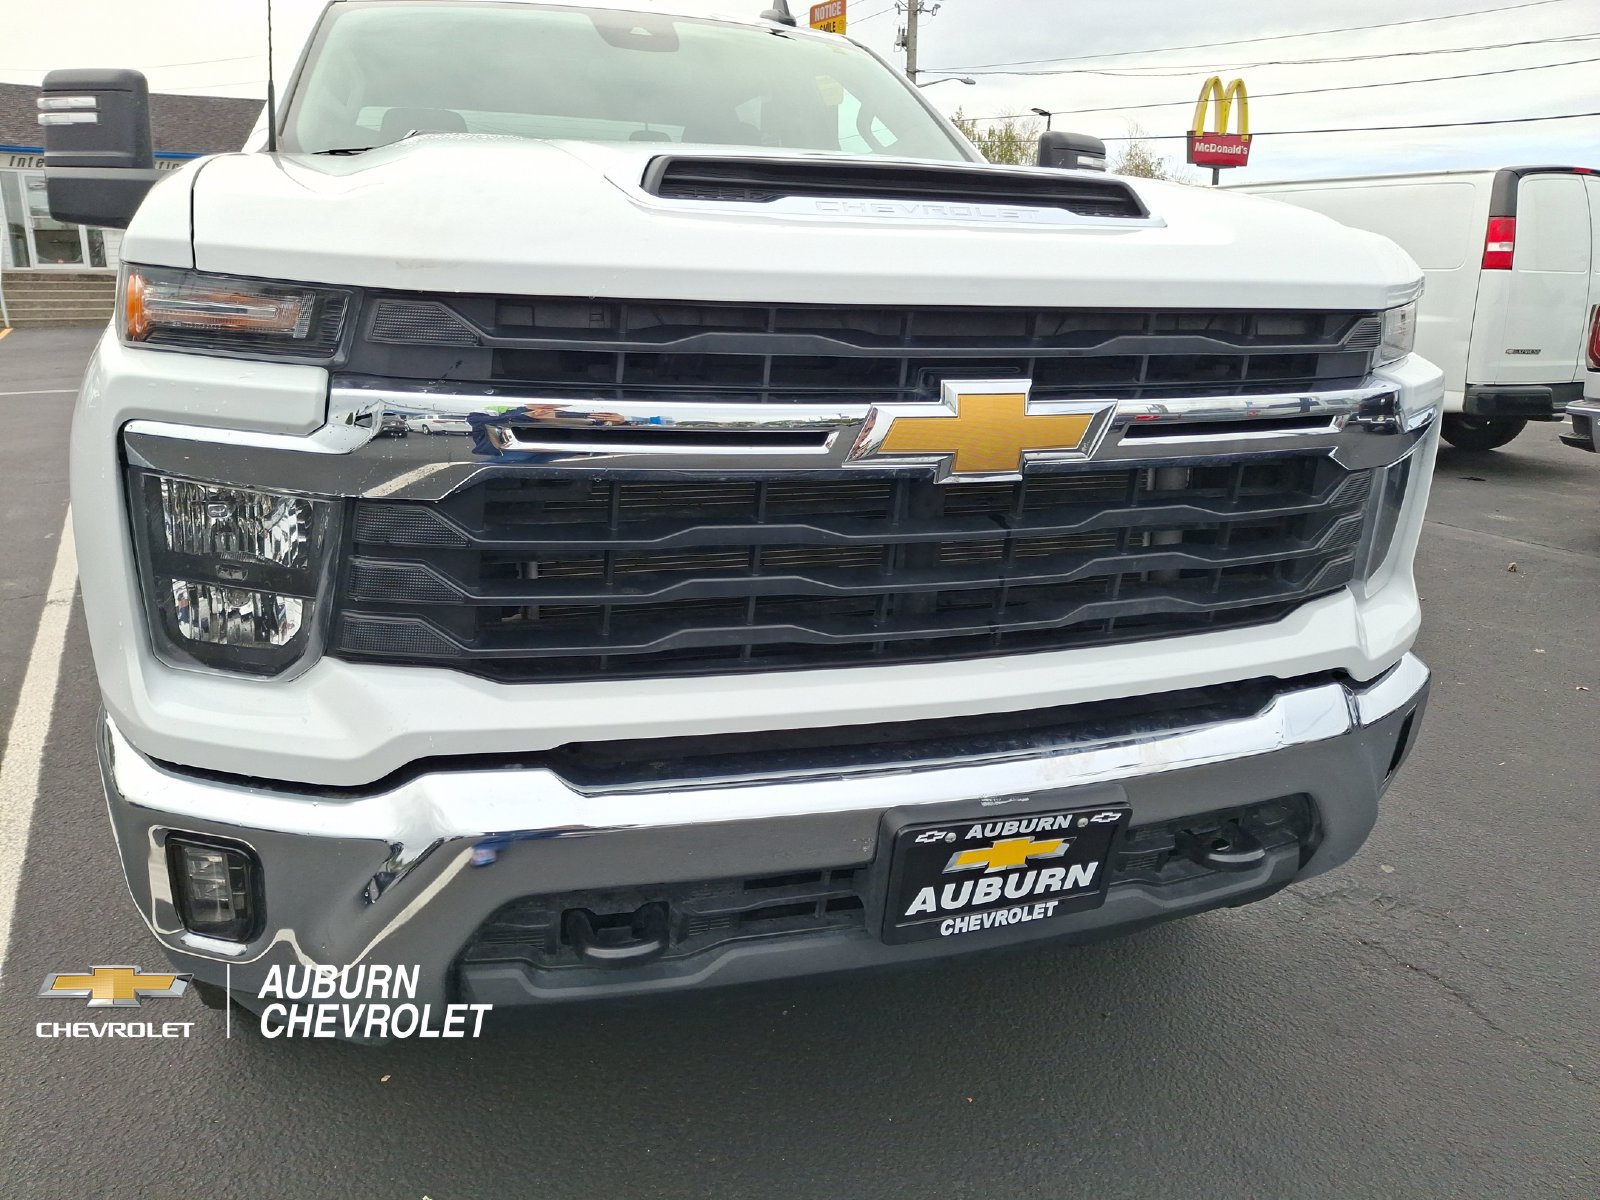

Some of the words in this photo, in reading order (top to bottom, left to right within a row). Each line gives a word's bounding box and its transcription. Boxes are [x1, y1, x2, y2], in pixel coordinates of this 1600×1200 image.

[814, 1, 842, 22] NOTICE
[1194, 142, 1248, 155] McDonald's
[815, 200, 1041, 220] CHEVROLET
[965, 814, 1073, 841] AUBURN
[904, 861, 1099, 917] AUBURN
[940, 900, 1059, 937] CHEVROLET
